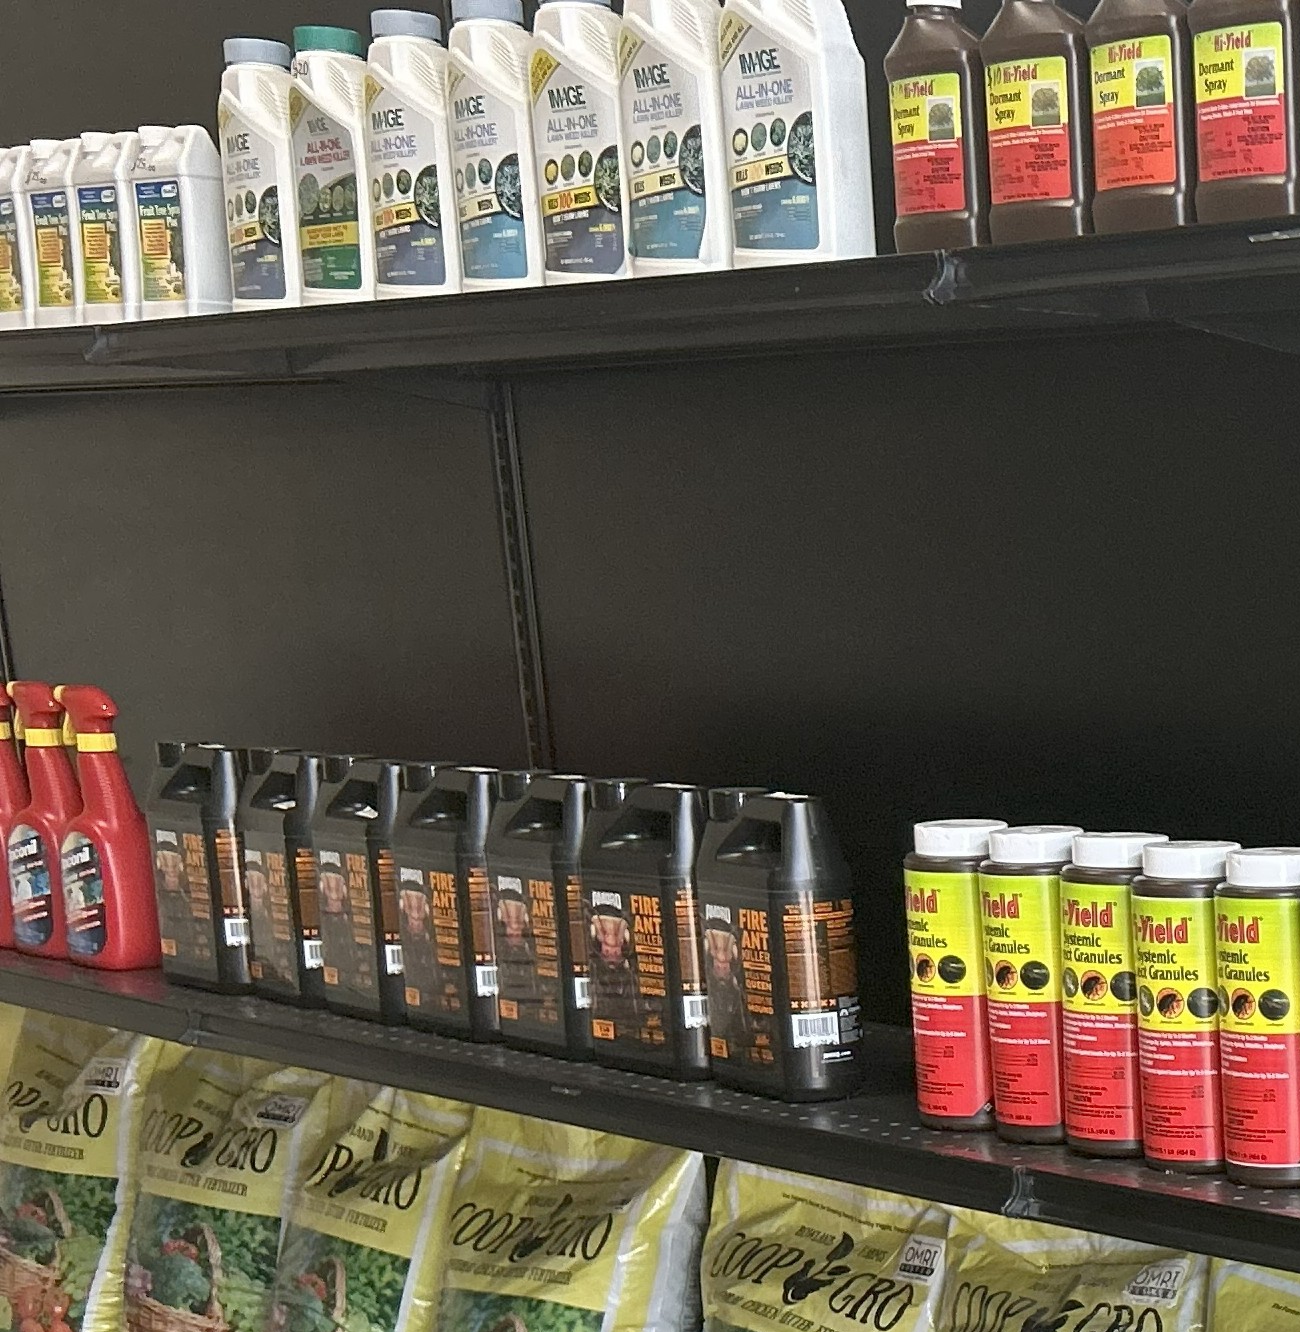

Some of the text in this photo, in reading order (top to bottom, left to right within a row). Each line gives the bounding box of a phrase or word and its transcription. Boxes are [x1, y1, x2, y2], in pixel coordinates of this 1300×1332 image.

[739, 48, 780, 74] IMAGE
[1199, 58, 1234, 76] Dormant
[633, 63, 669, 86] IMAGE
[1204, 78, 1228, 94] Spray
[548, 85, 585, 109] IMAGE
[736, 79, 793, 101] ALL-IN-ONE
[630, 894, 660, 917] FIRE
[634, 915, 661, 934] ANT
[738, 908, 768, 931] FIRE
[741, 930, 769, 951] ANT
[904, 1245, 939, 1268] OMRI
[710, 1231, 914, 1332] COOP GRO
